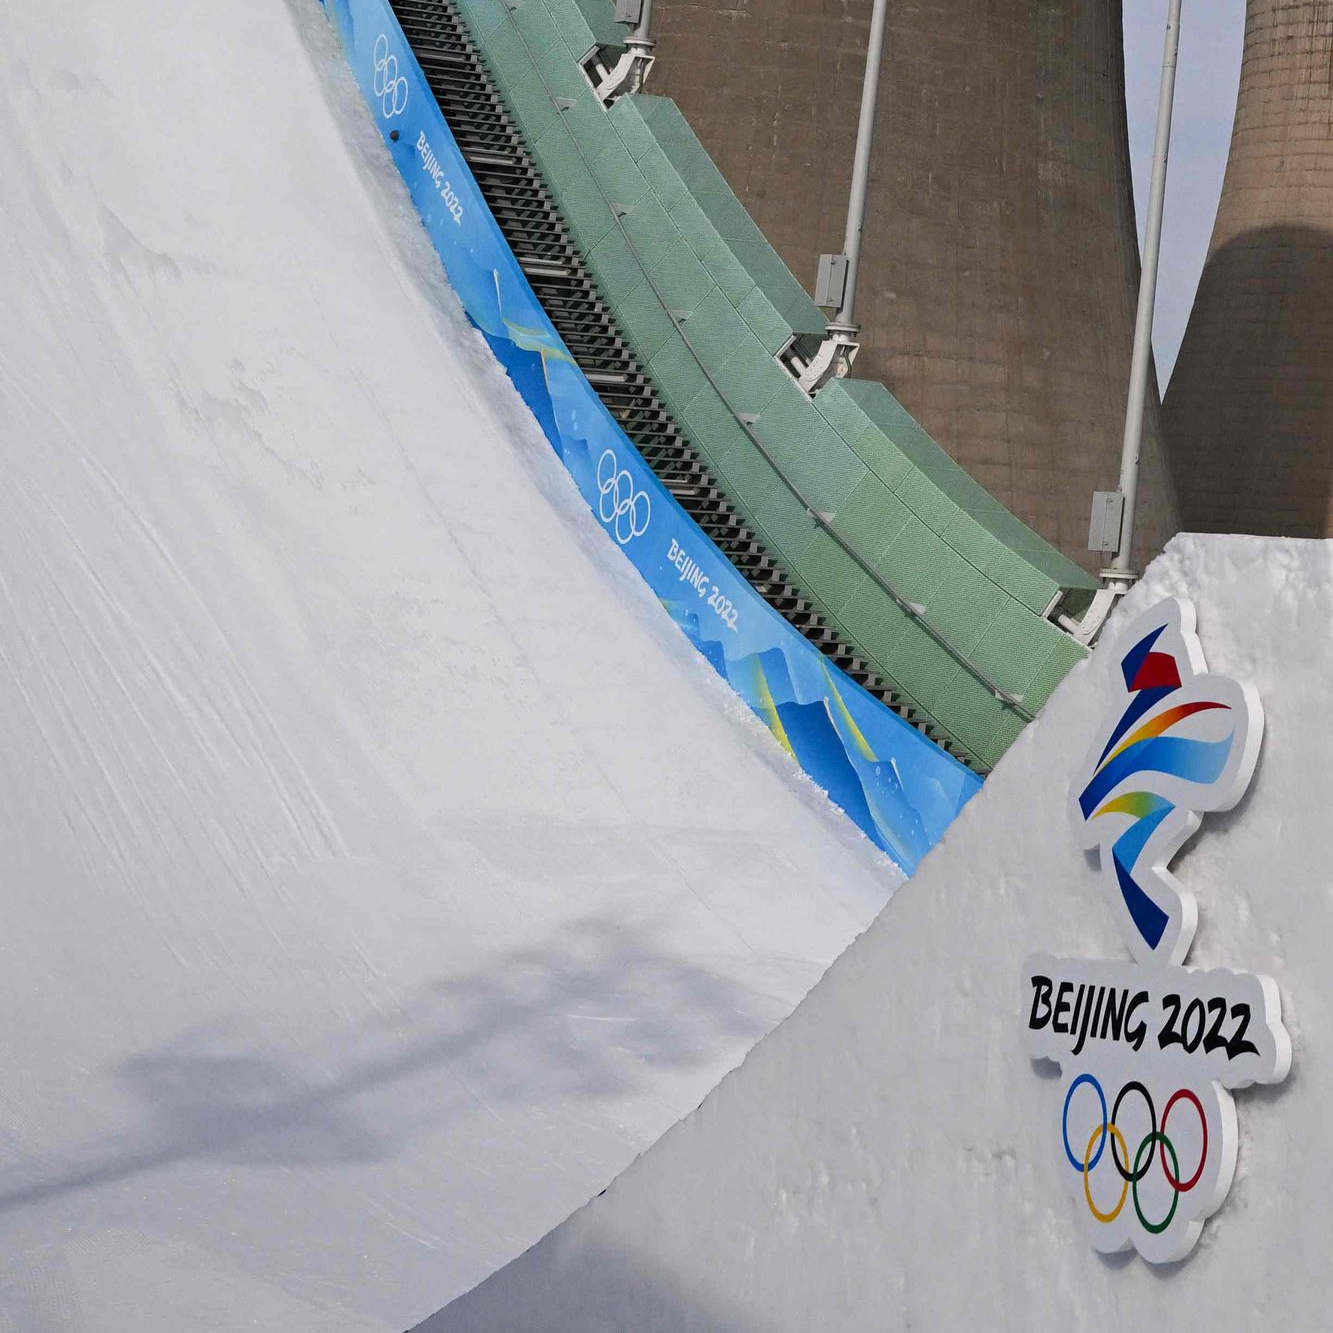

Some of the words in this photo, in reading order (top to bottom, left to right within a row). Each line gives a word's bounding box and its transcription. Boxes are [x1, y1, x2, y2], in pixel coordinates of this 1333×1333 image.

[416, 130, 444, 188] BEIJING
[441, 181, 463, 227] 2022
[667, 538, 709, 598] BEIJING
[707, 585, 739, 634] 2022
[1028, 975, 1149, 1056] BEIJING
[1157, 993, 1261, 1061] 2022
